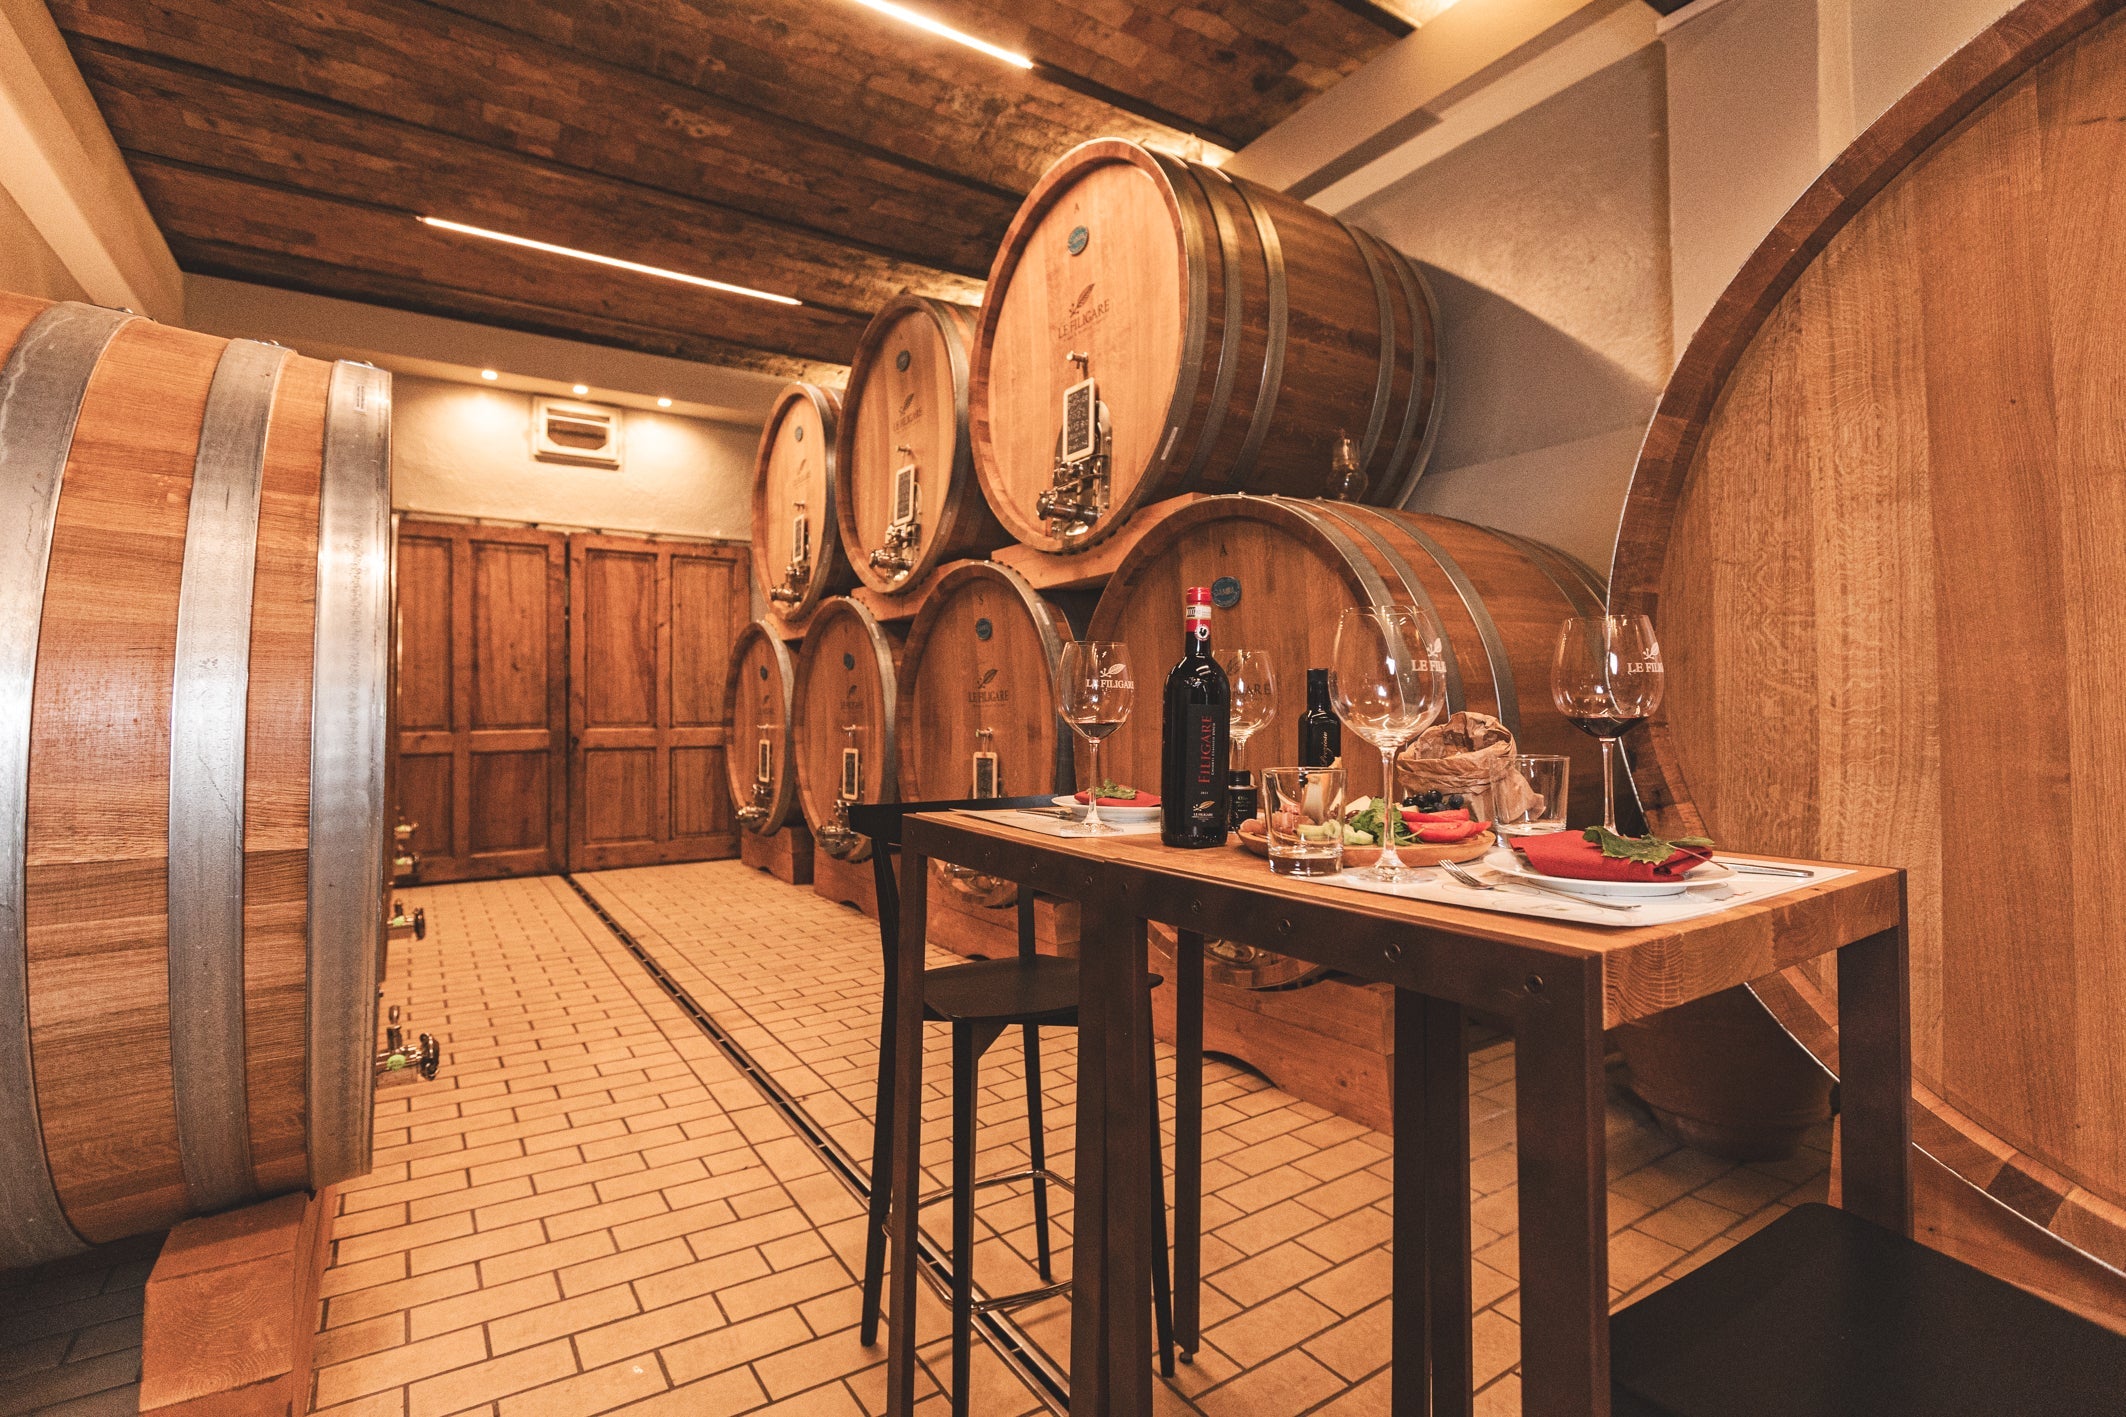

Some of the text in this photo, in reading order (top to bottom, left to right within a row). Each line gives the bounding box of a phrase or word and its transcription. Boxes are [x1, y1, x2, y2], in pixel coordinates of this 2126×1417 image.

[1058, 323, 1069, 339] LE
[1070, 299, 1110, 334] FILIGARE
[1411, 659, 1428, 672] LE
[1627, 662, 1643, 674] LE
[1198, 715, 1212, 784] FILIGARE
